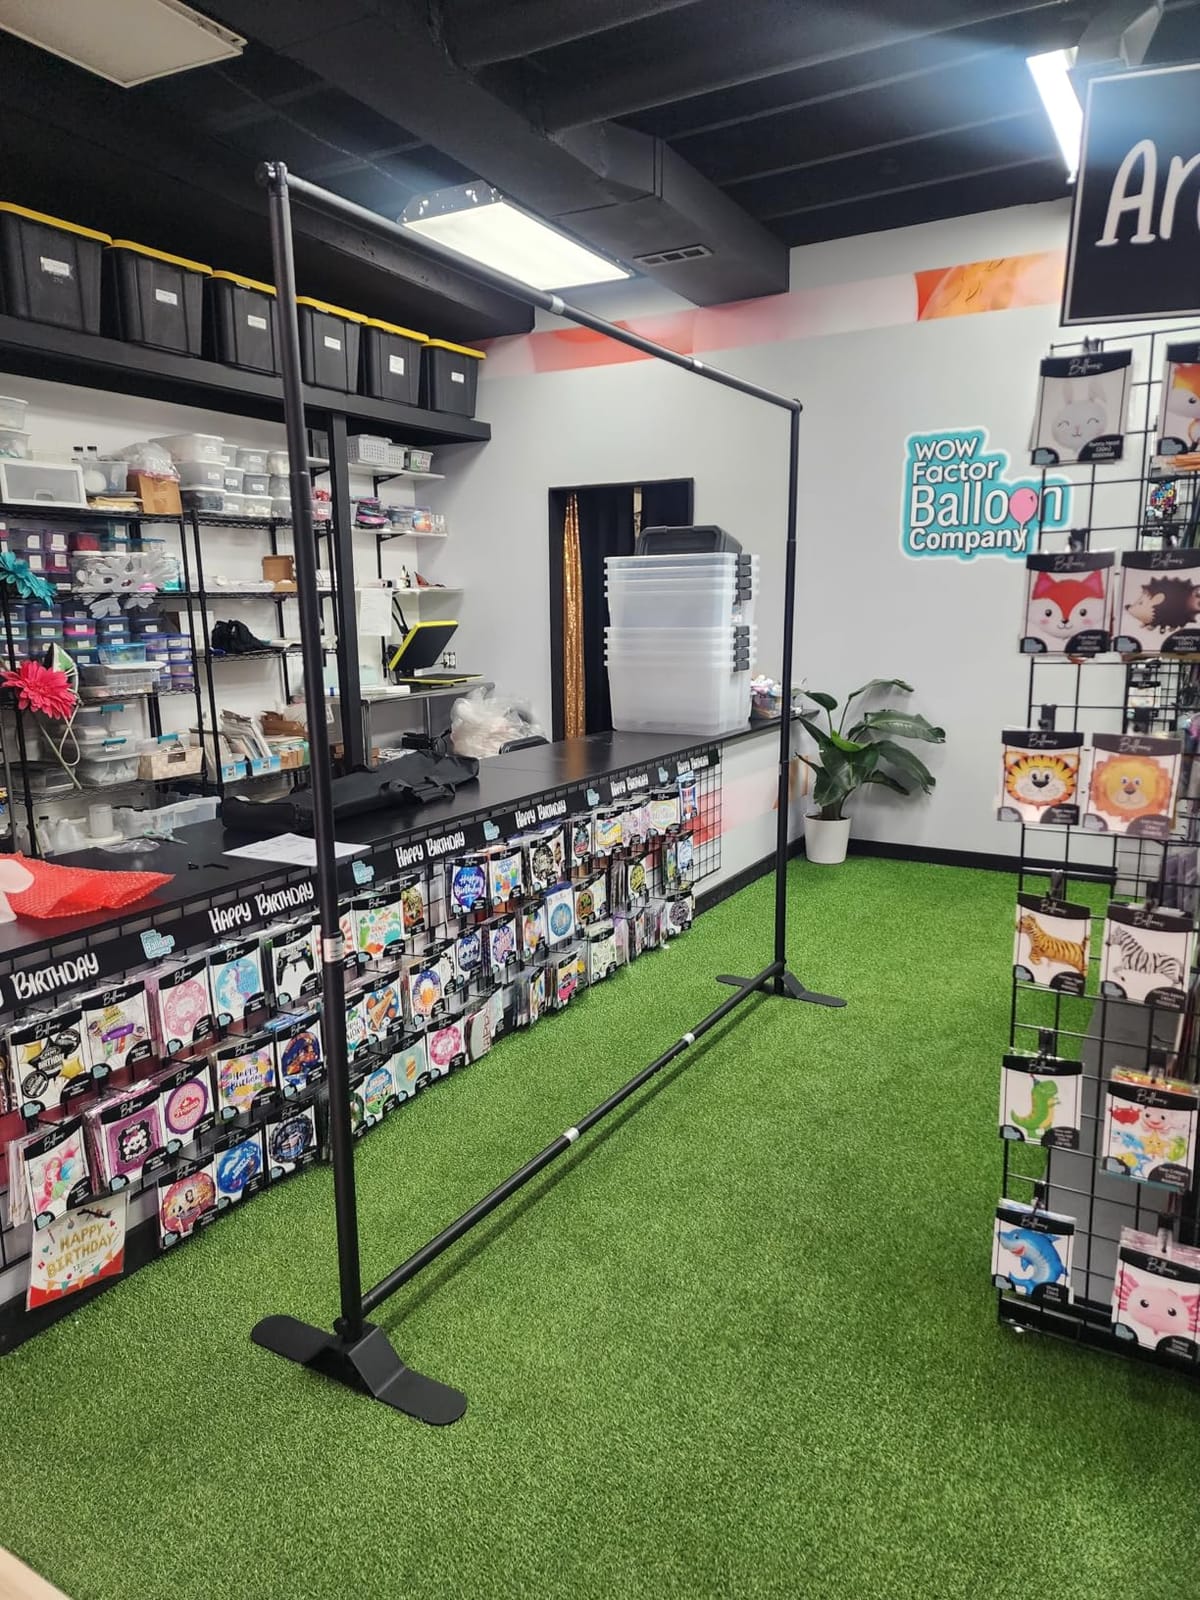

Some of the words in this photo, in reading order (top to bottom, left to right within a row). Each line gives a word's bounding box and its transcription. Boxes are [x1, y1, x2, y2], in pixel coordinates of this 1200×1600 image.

[914, 437, 978, 461] WOW
[912, 460, 1000, 484] Factor
[909, 482, 1064, 528] Balloon
[909, 526, 1027, 553] Company
[395, 844, 424, 868] HAPPY
[425, 831, 466, 857] BIRTHDAY
[207, 901, 252, 934] HAPPY
[254, 881, 315, 916] BIRTHDAY
[9, 952, 100, 1000] BIRTHDAY
[46, 1231, 115, 1279] BIRTHDAY
[60, 1222, 105, 1251] HAPPY
